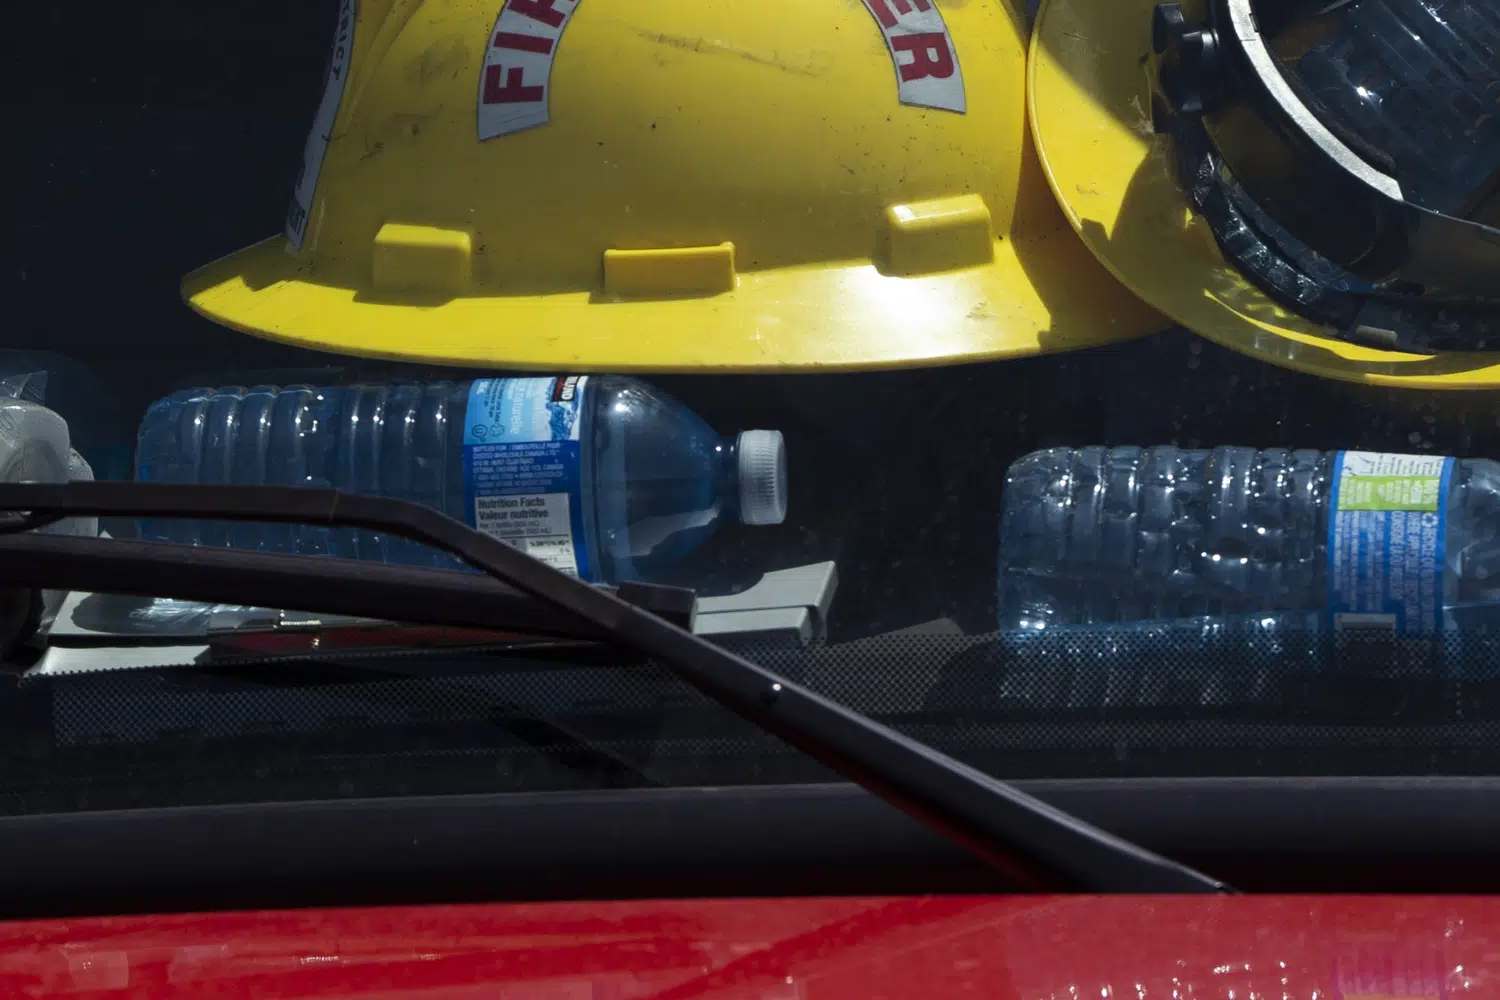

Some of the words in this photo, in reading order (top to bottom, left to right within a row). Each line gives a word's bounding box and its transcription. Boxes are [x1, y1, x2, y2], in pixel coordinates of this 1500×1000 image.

[478, 497, 517, 508] Nutrition
[520, 497, 544, 506] Facts
[479, 511, 507, 519] Valeur
[510, 508, 547, 517] nutritive
